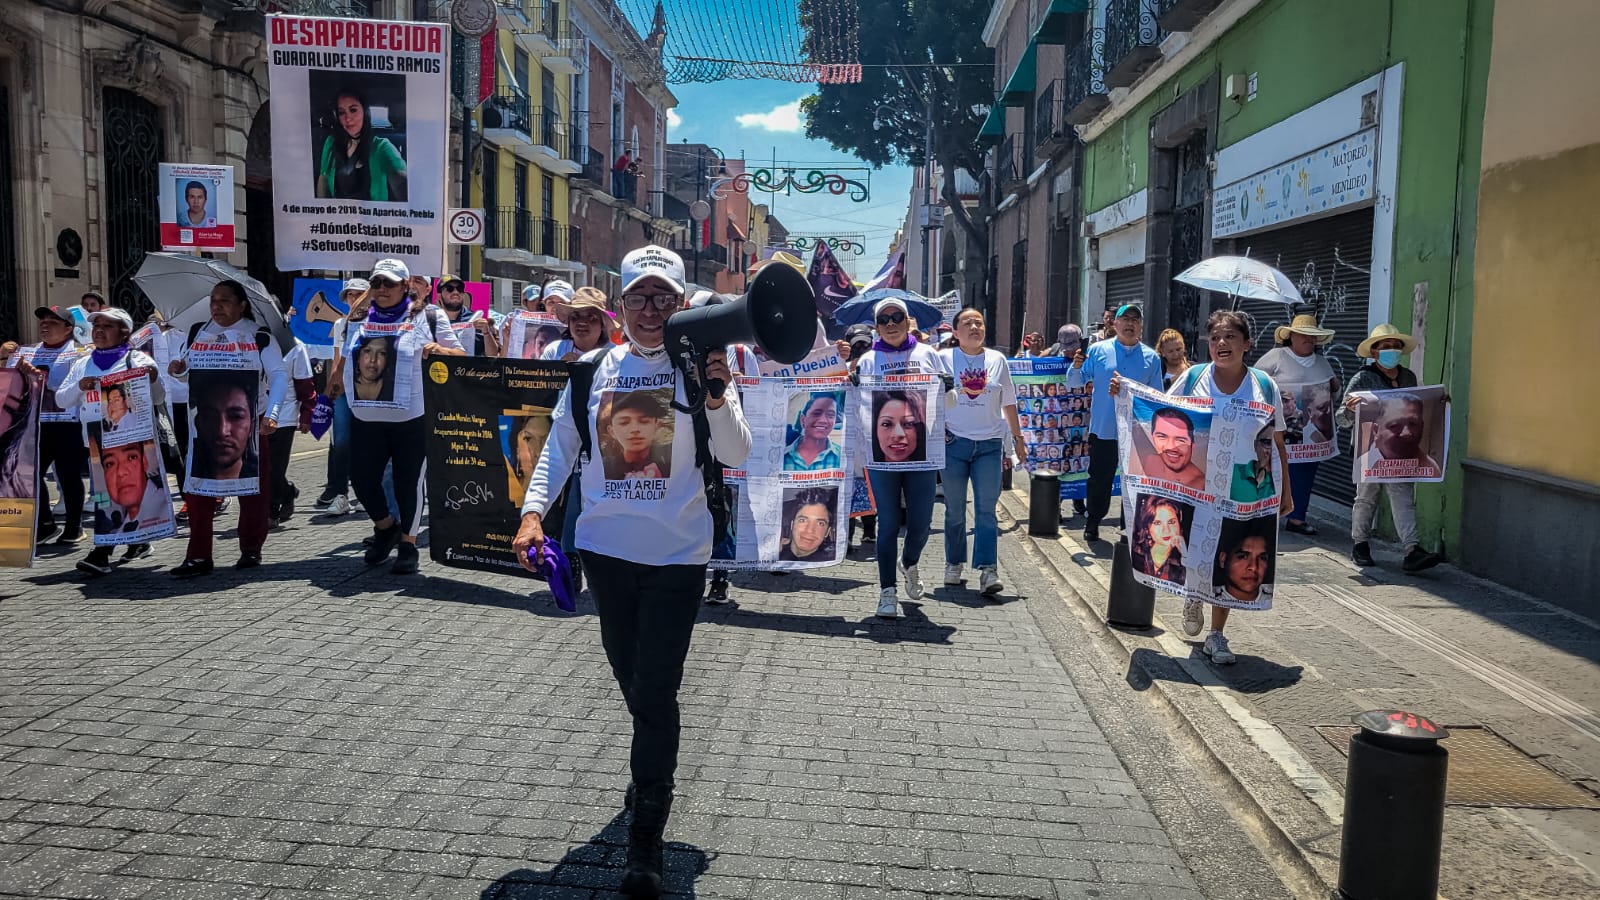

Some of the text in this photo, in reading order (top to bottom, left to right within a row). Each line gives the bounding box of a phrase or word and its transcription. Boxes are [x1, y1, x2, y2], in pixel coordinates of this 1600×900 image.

[271, 17, 441, 53] DESAPARECIDA
[273, 49, 441, 74] GUADALUPE LARIOS RAMOS
[1332, 144, 1368, 168] MAYOREO
[1347, 164, 1353, 176] Y
[1331, 173, 1367, 195] MENUDEO
[282, 204, 289, 213] 4
[290, 204, 300, 213] de
[302, 206, 325, 216] mayo
[326, 205, 337, 214] de
[338, 205, 358, 215] 2018
[358, 208, 371, 216] San
[409, 210, 435, 219] Puebla
[458, 216, 475, 228] 30
[310, 222, 413, 238] #DóndeEstáLupita
[454, 366, 466, 376] 30
[465, 367, 476, 377] de
[605, 371, 675, 389] DESAPARECIDO
[437, 411, 456, 421] Claudia
[1294, 451, 1320, 460] OCTUBRE
[634, 479, 668, 491] ARIEL
[452, 552, 474, 561] Colectivo
